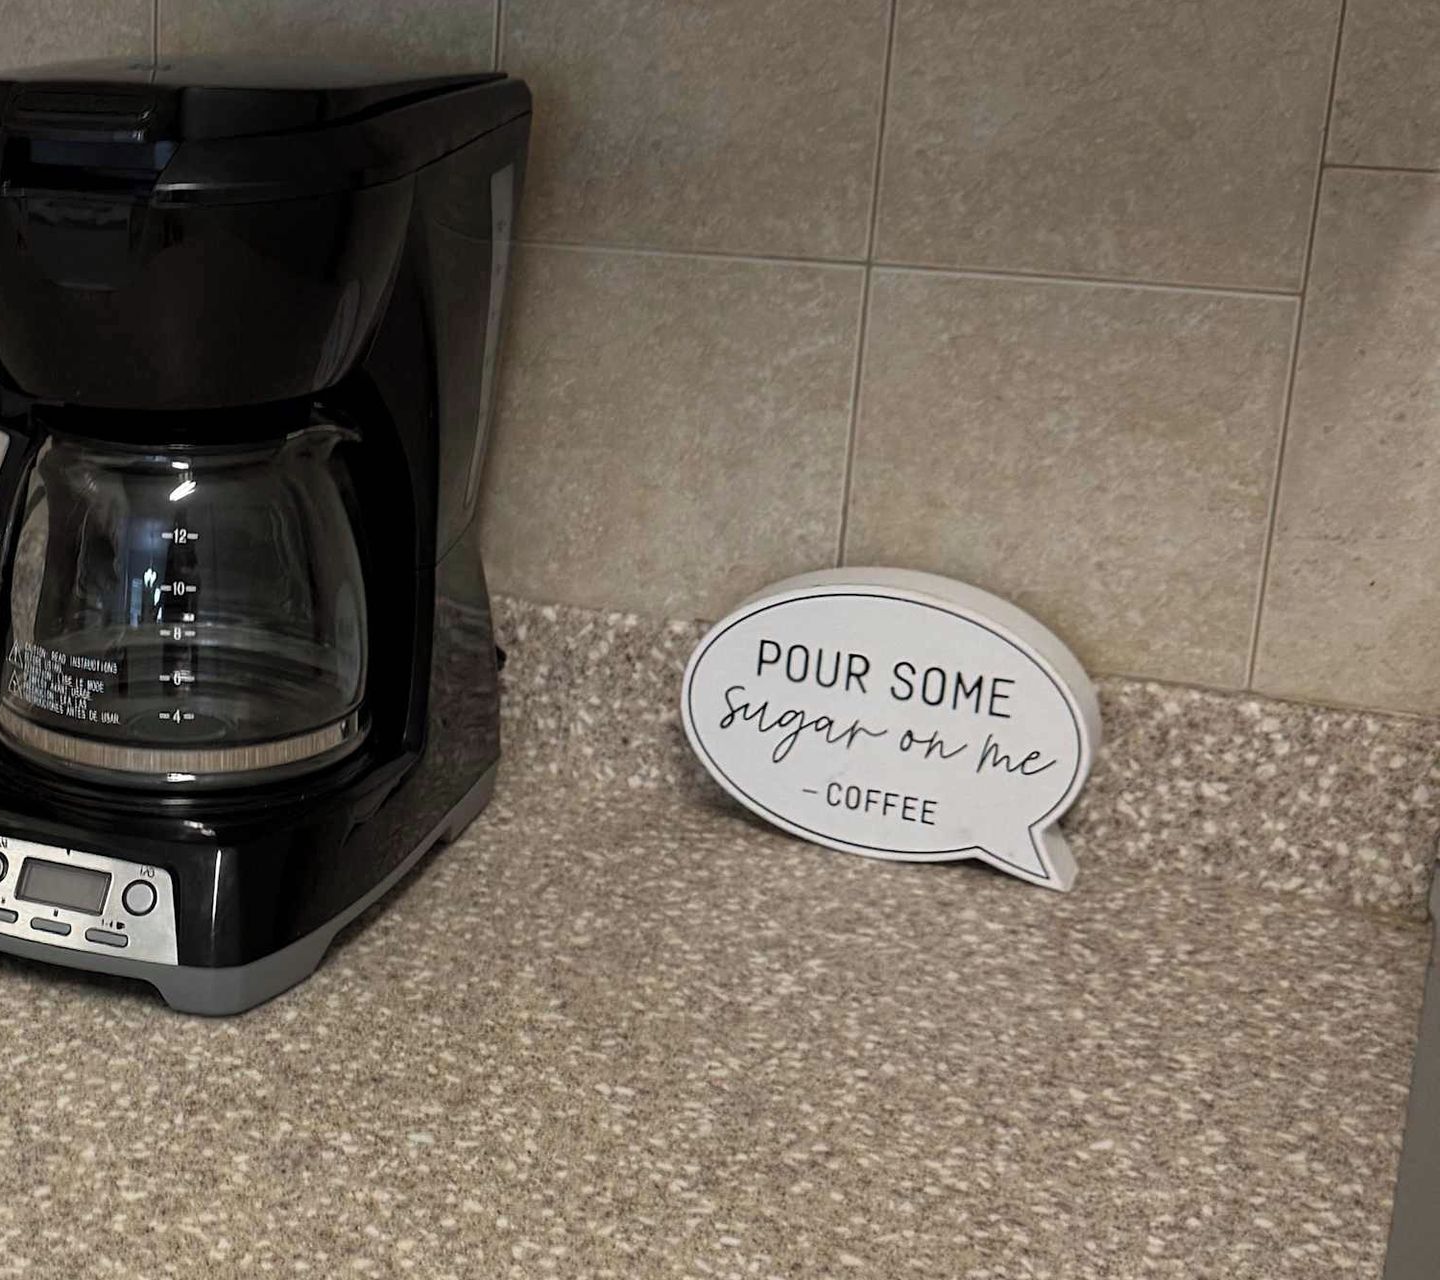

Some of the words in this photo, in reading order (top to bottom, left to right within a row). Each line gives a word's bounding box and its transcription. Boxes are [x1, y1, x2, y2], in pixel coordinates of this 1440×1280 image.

[173, 528, 187, 544] 12
[172, 581, 185, 596] 10
[174, 627, 181, 640] 8
[756, 638, 871, 694] POUR
[890, 660, 1016, 719] SOME
[172, 709, 180, 724] 4
[719, 684, 888, 764] sugar
[899, 728, 968, 759] on
[976, 732, 1057, 776] me
